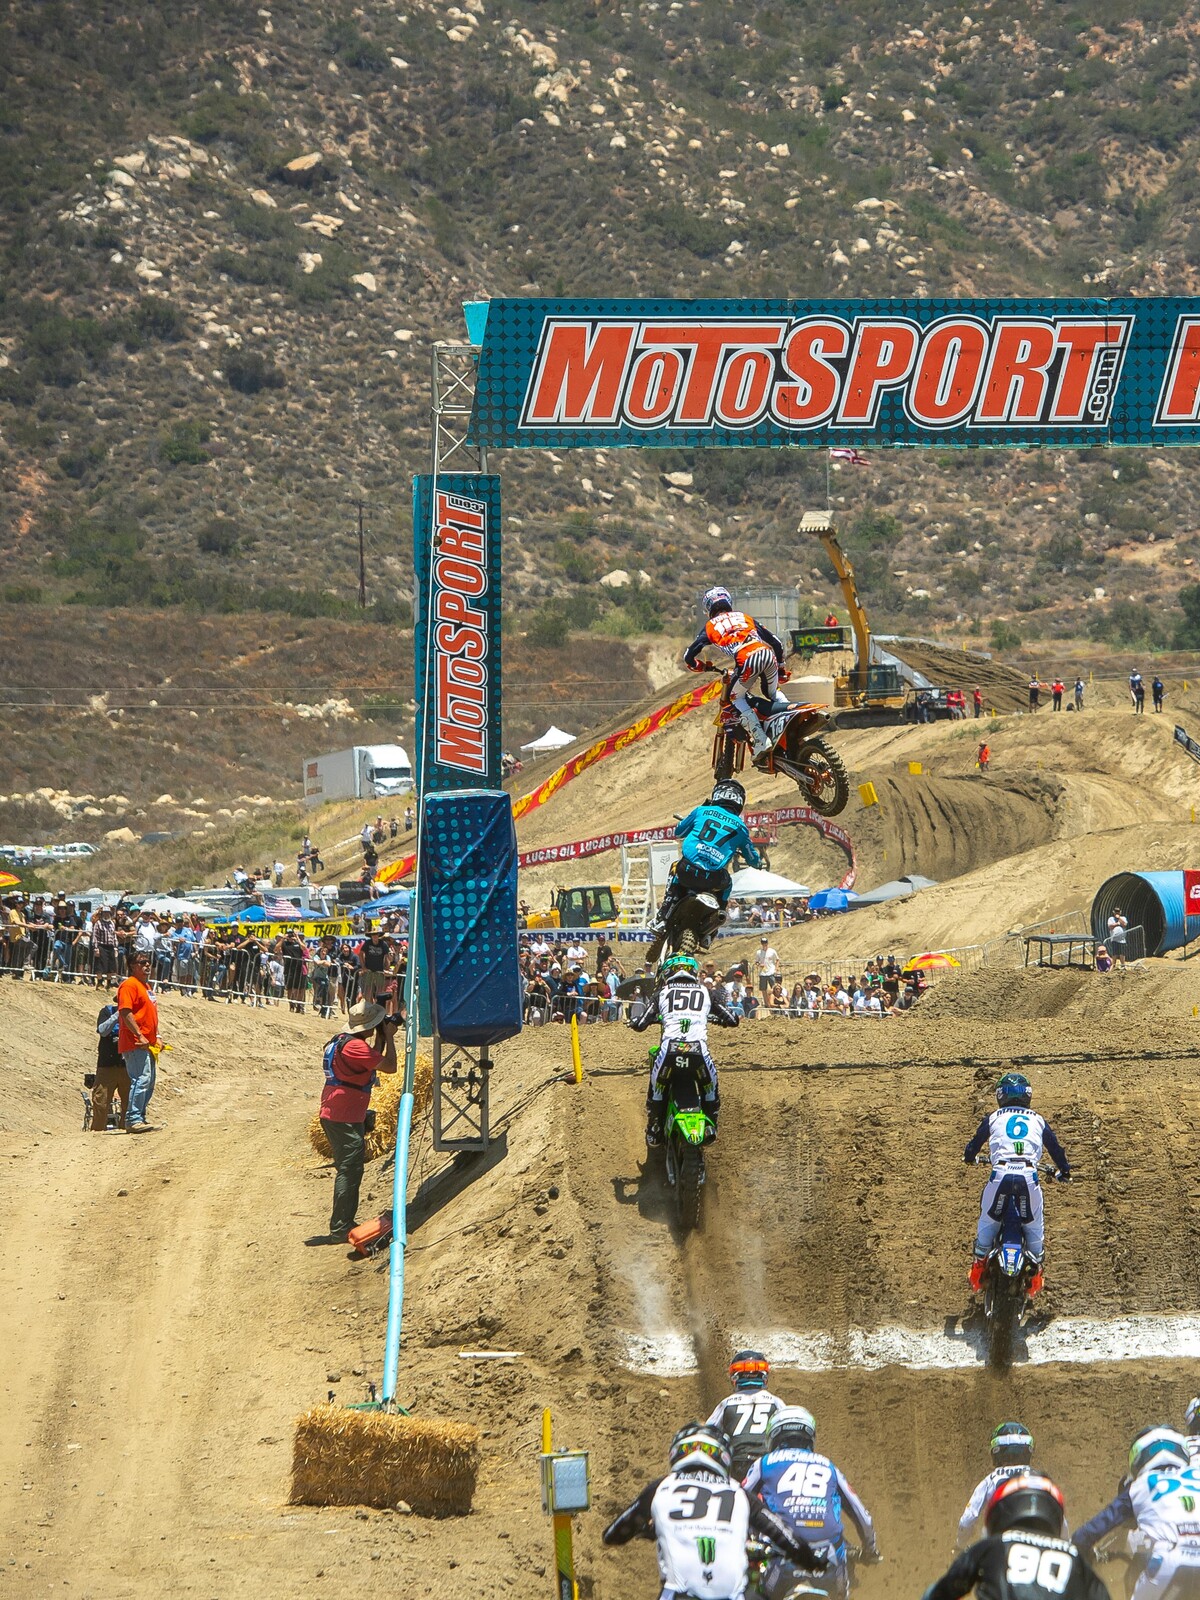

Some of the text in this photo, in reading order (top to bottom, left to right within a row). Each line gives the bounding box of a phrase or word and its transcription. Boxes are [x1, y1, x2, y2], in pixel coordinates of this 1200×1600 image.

[713, 617, 749, 637] 115
[526, 847, 557, 864] LUCAS
[559, 846, 576, 858] OIL
[580, 837, 611, 854] LUCAS
[613, 833, 628, 844] OIL
[633, 828, 664, 843] LUCAS
[699, 819, 738, 848] 67
[665, 989, 705, 1013] 150
[1005, 1115, 1029, 1139] 6
[733, 1404, 771, 1436] 75
[777, 1463, 832, 1498] 48
[669, 1484, 736, 1522] 31
[1006, 1543, 1073, 1594] 90
